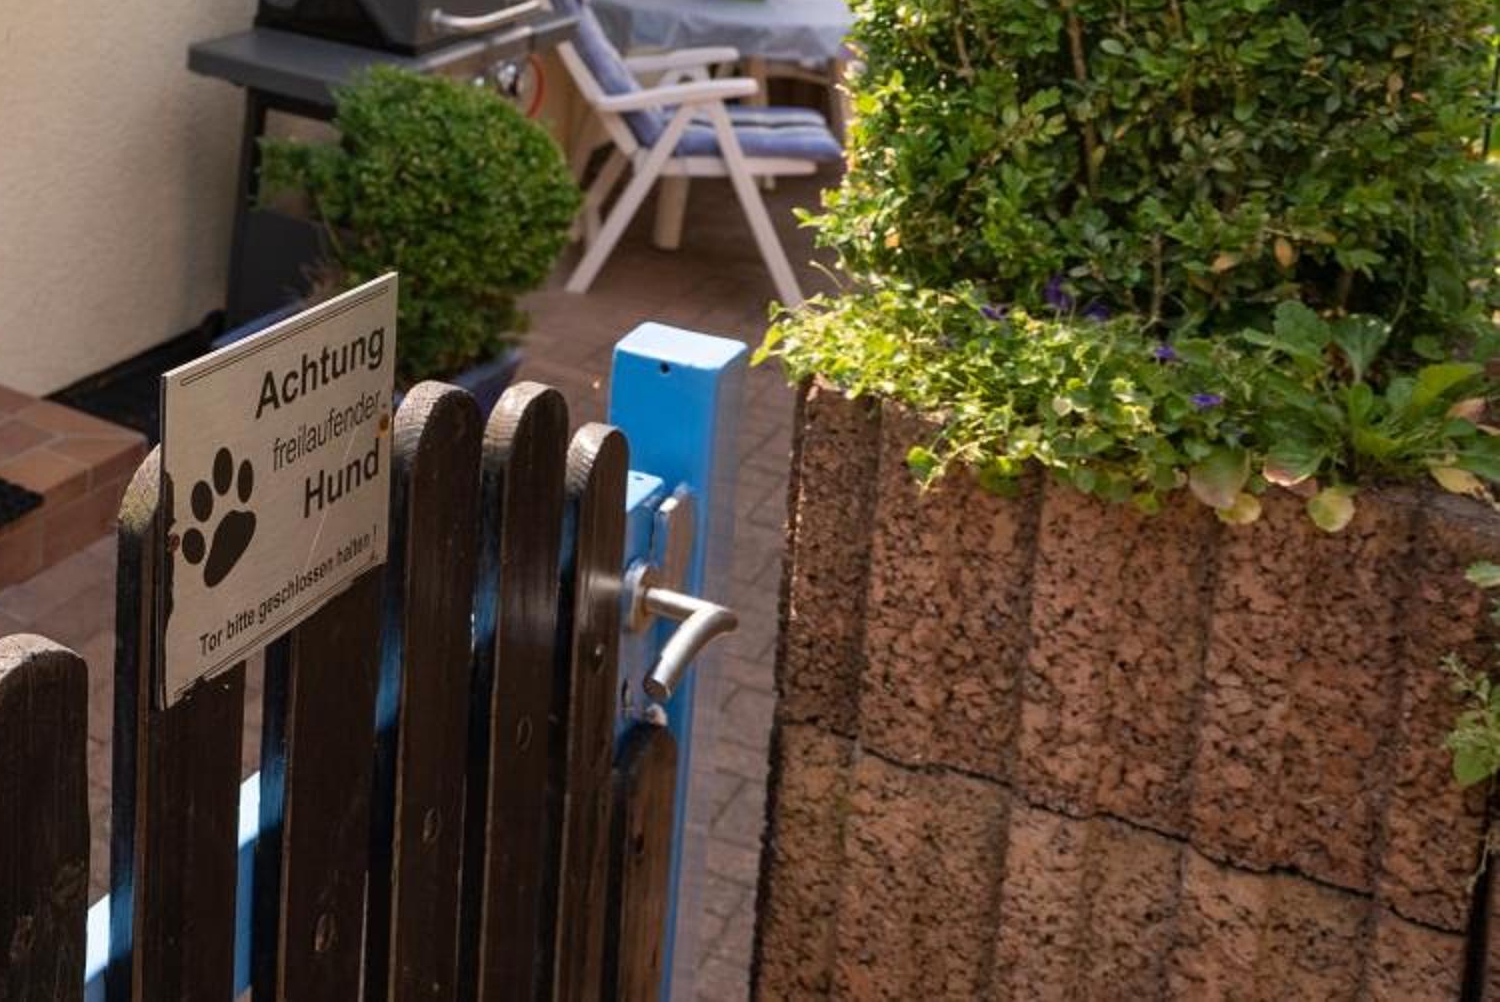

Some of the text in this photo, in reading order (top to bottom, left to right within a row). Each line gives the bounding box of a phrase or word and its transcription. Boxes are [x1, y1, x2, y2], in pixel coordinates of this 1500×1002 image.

[255, 325, 385, 419] Achtung
[273, 390, 381, 472] freilaufender
[304, 437, 380, 519] Hund
[199, 629, 223, 657] Tor
[227, 609, 255, 639] bitte
[259, 557, 333, 625] geschlossen
